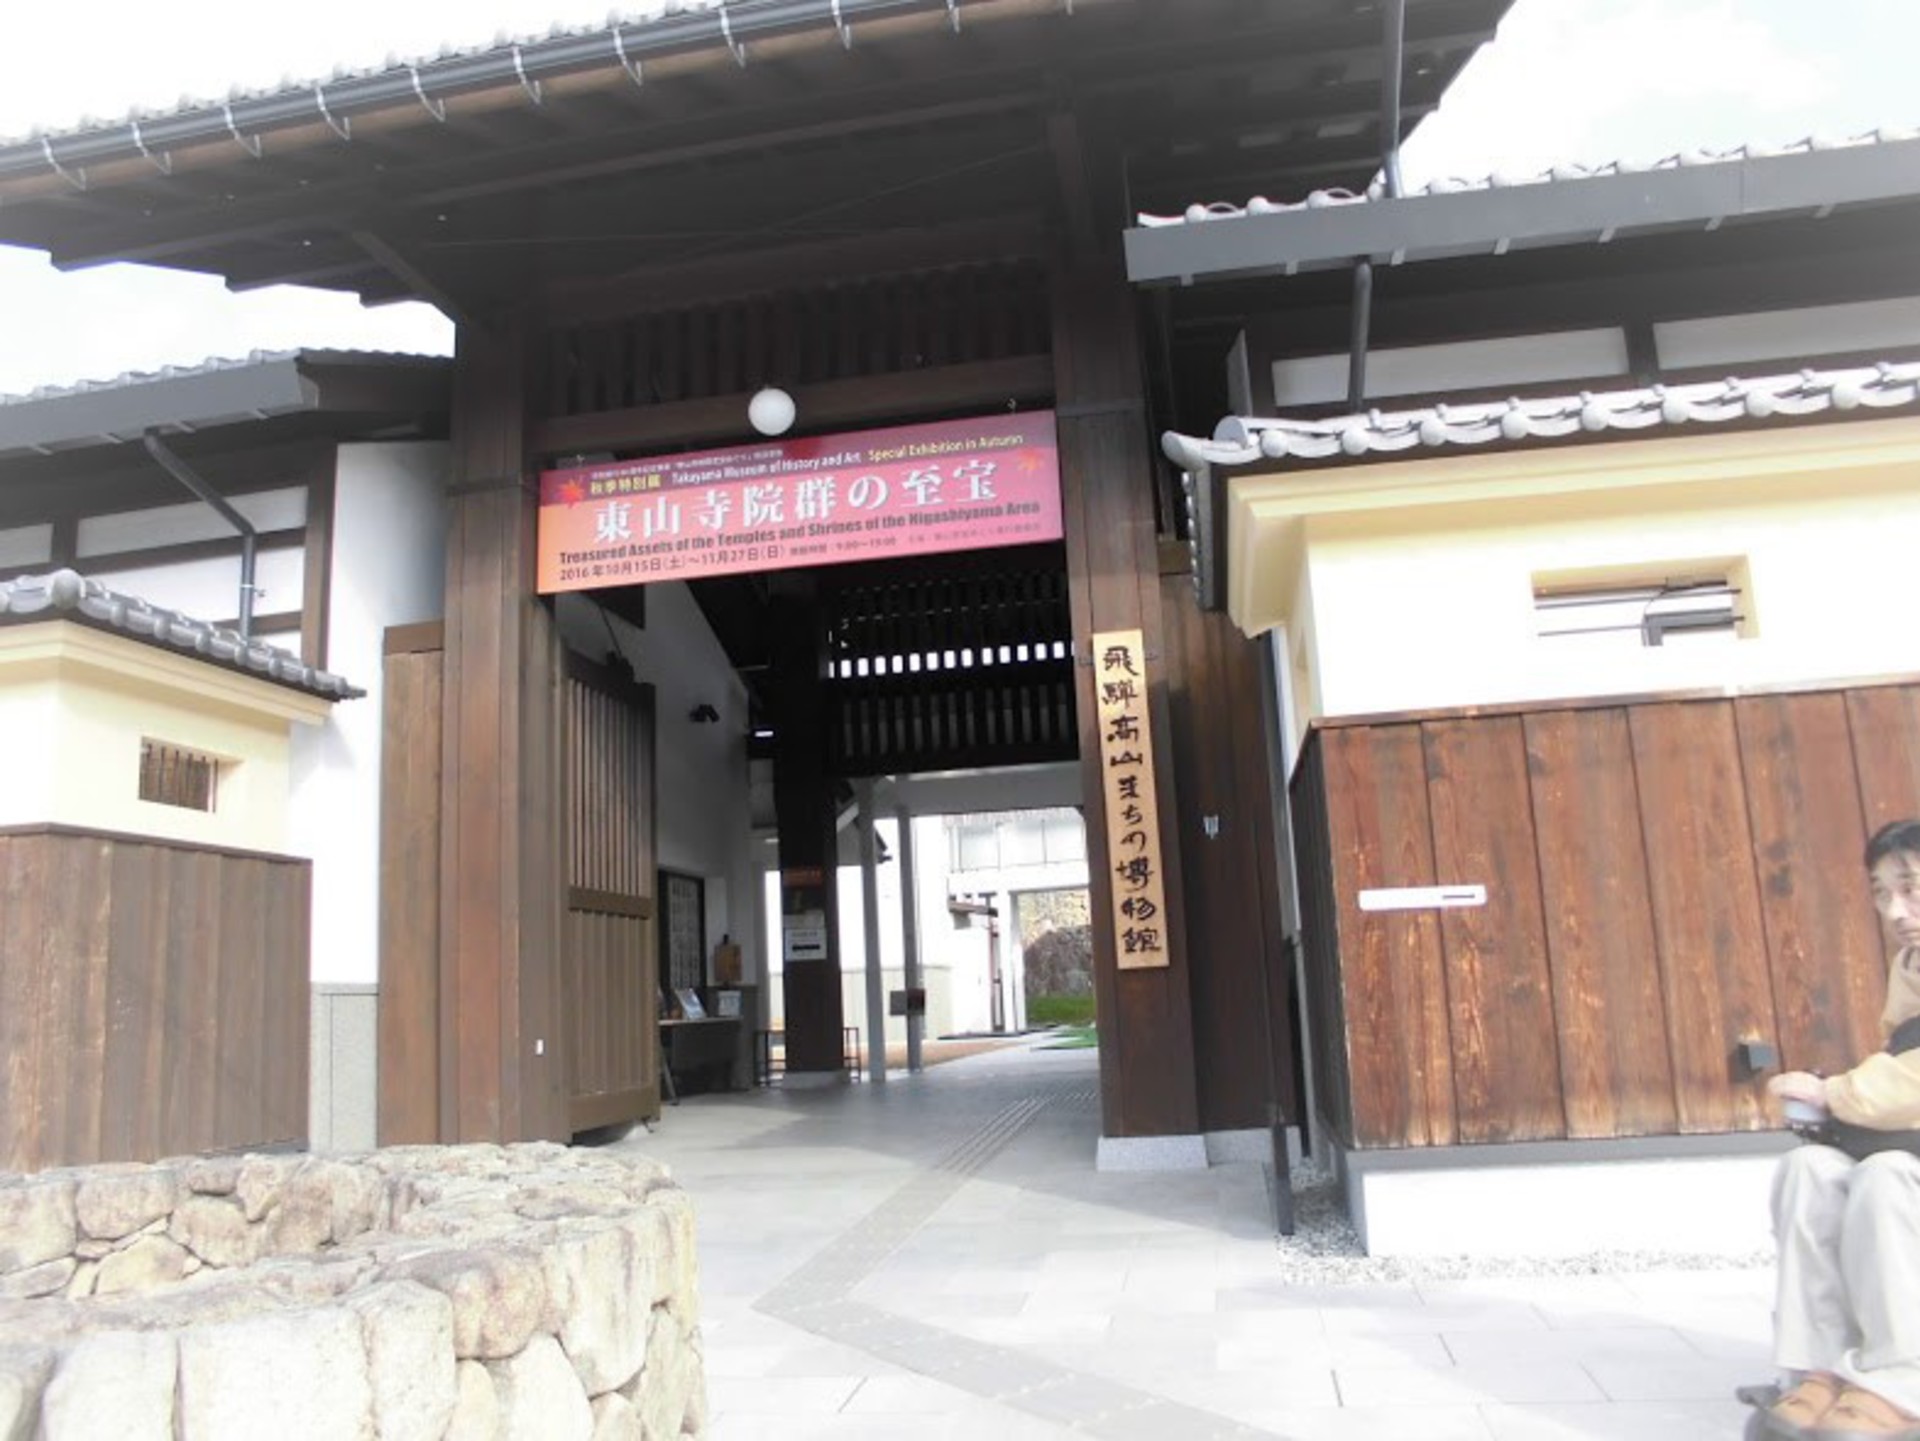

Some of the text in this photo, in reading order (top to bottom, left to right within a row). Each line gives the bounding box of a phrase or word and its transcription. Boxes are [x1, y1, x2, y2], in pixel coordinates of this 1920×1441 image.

[671, 471, 722, 484] Takayama
[724, 463, 767, 479] Museum
[769, 460, 781, 472] of
[782, 456, 820, 472] History
[821, 454, 843, 467] and
[843, 451, 862, 464] Art
[868, 434, 1024, 463] Special Exhibition in Autumn
[594, 458, 998, 546] 東山寺院群の至宝
[560, 500, 1041, 564] Treasured Assets of the Temples and Shrines of the Higashiyama Area
